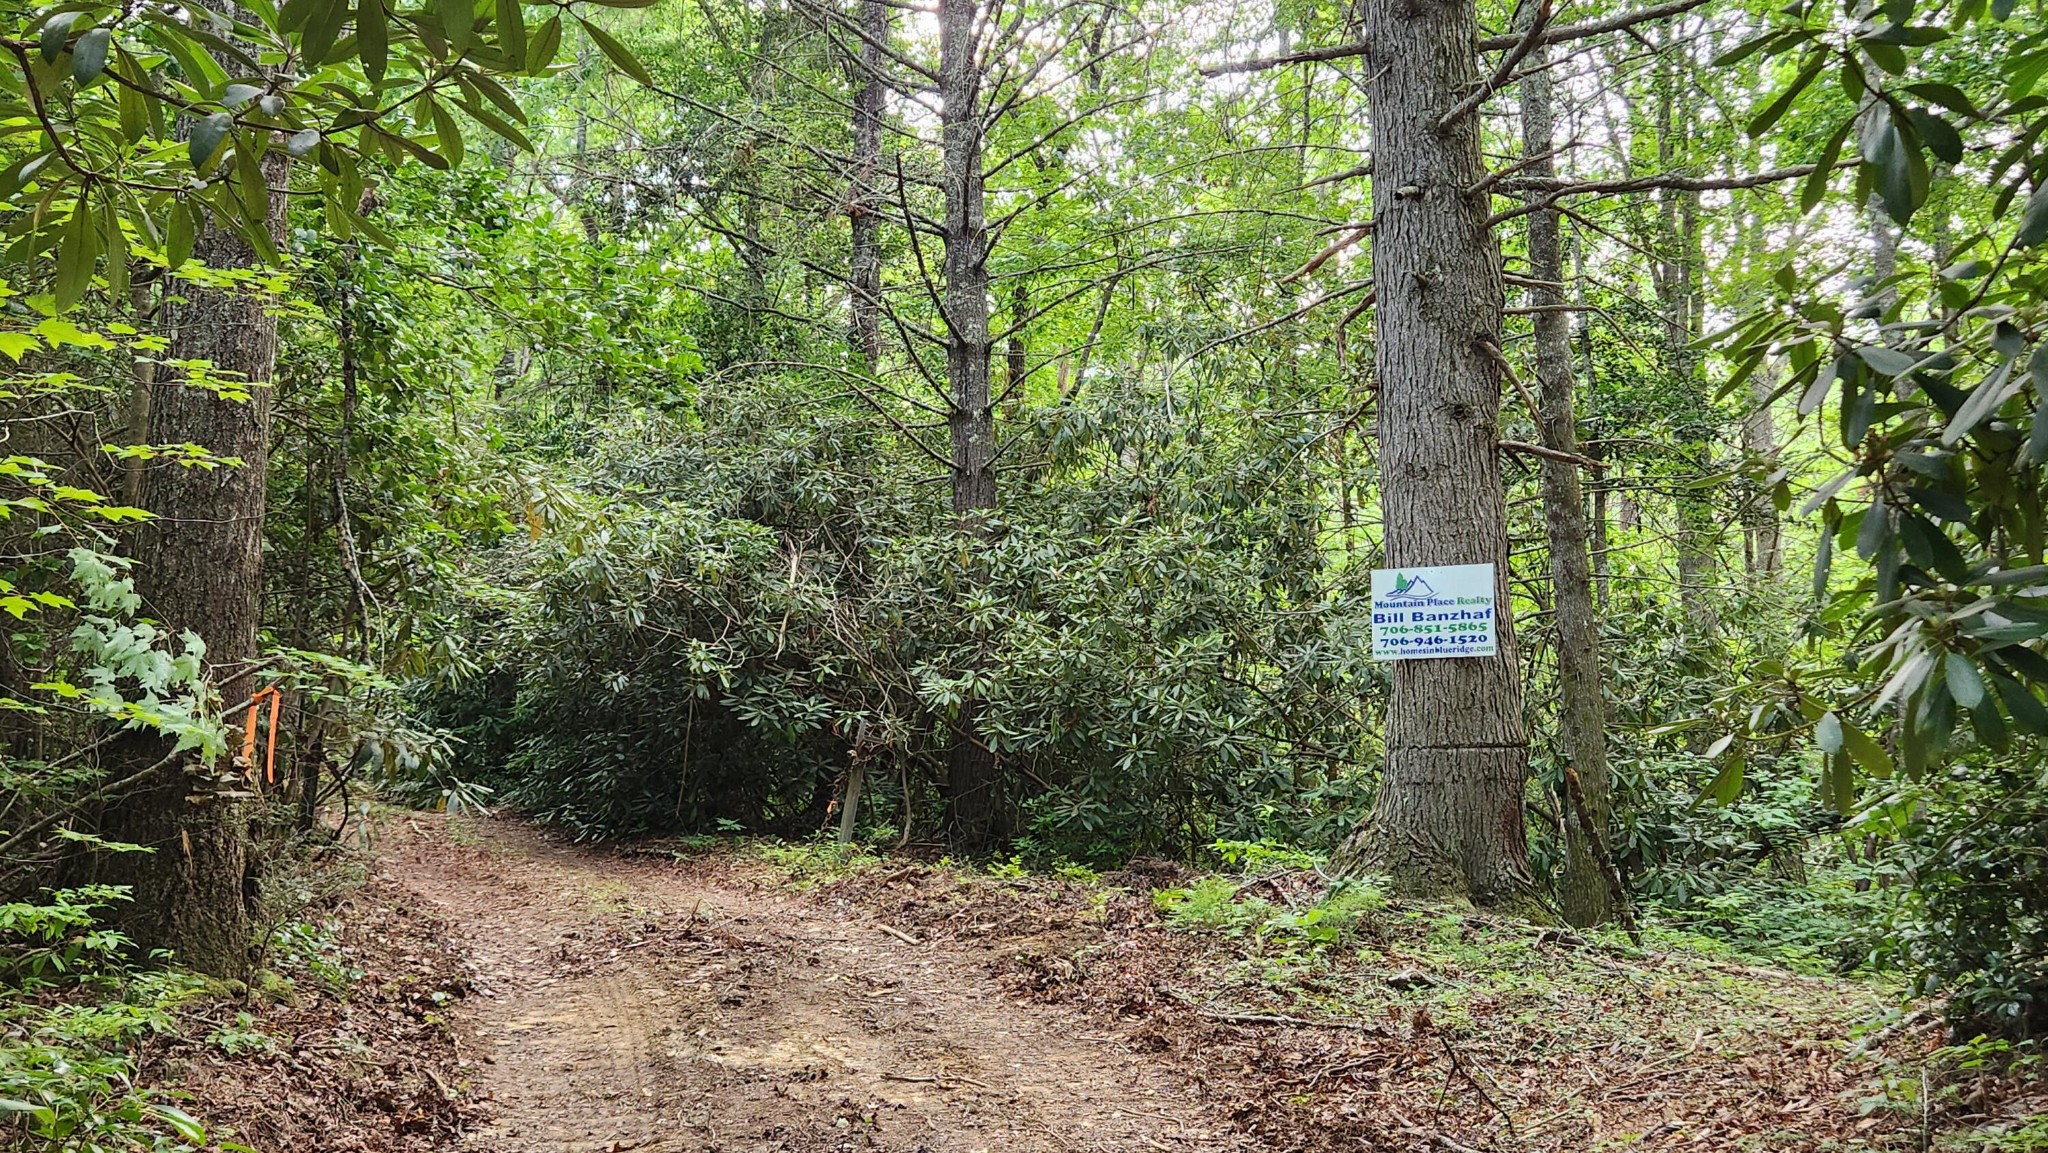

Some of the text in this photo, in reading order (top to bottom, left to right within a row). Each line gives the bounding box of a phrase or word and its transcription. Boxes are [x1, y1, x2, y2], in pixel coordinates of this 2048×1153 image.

[1374, 596, 1492, 609] Mountain Place Realty
[1373, 608, 1492, 624] Bill Banzhaf
[1380, 622, 1488, 636] 706-851-5865
[1380, 634, 1488, 648] 706-946-1520
[1375, 645, 1494, 655] www.homesinblueridge.com
